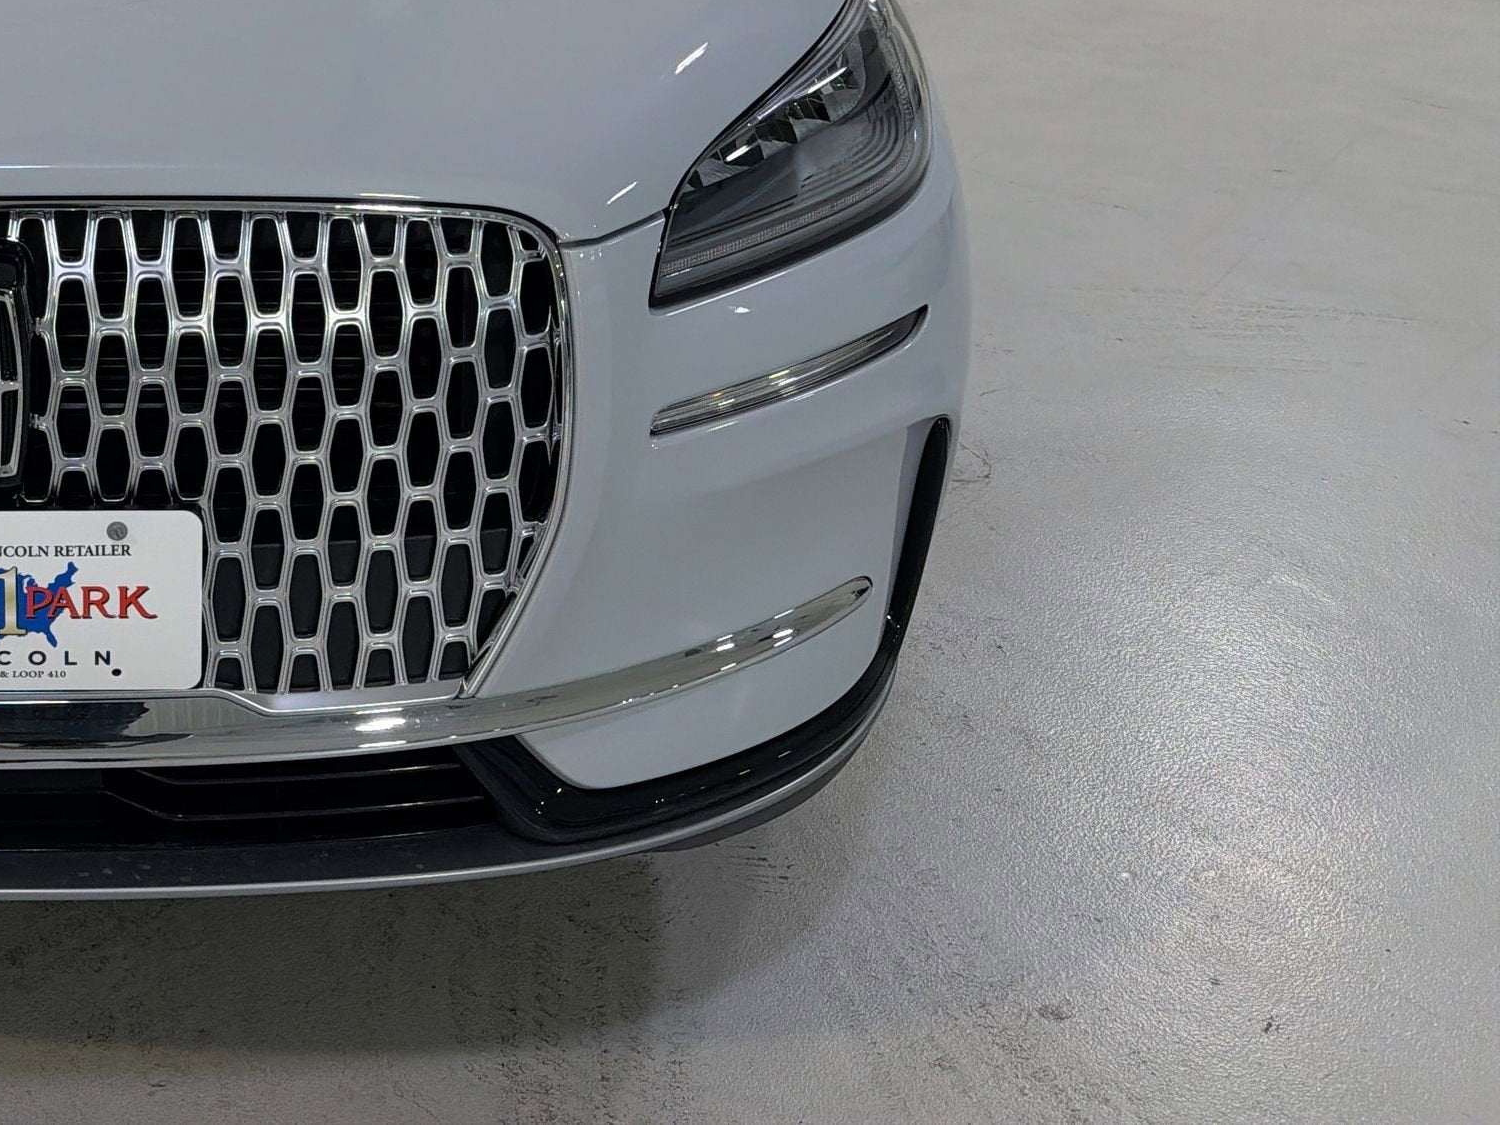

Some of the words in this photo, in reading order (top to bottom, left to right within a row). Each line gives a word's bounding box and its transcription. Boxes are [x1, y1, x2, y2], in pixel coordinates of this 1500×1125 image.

[53, 544, 132, 557] RETAILER
[25, 585, 158, 620] PARK
[0, 670, 9, 678] &
[12, 670, 44, 678] LOOP
[47, 670, 67, 678] 410
